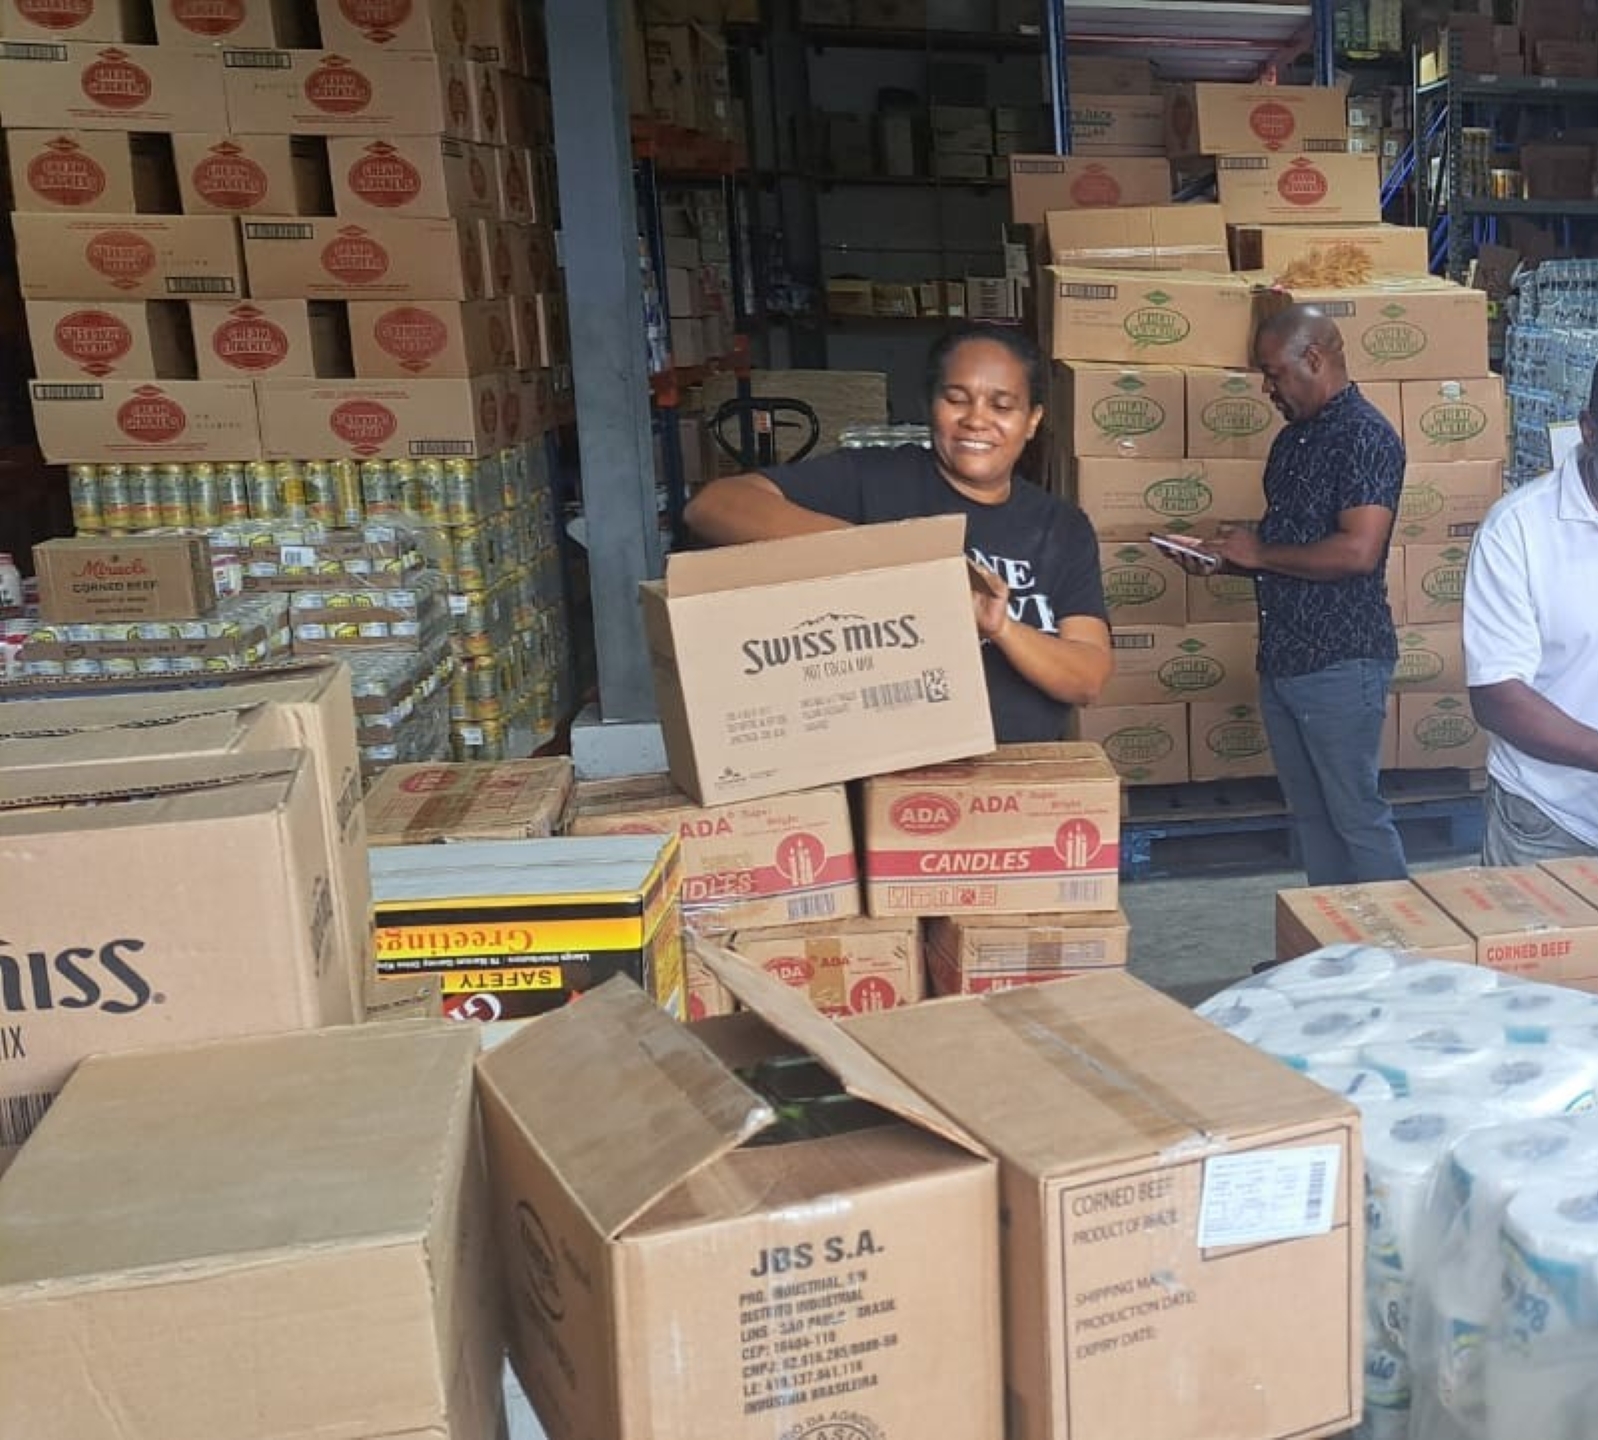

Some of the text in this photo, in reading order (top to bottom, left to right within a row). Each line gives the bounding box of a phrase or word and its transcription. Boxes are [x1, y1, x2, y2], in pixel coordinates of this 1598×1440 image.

[742, 629, 837, 675] SWISS
[900, 806, 950, 824] ADA
[969, 795, 1019, 815] ADA
[680, 817, 733, 840] ADA
[919, 851, 1031, 873] CANDLES
[682, 870, 753, 900] DLES
[1487, 940, 1572, 962] CORNED BEEF
[460, 969, 552, 989] SAFETY
[1071, 1185, 1134, 1217] CORNED
[750, 1229, 885, 1277] JBS S.A.
